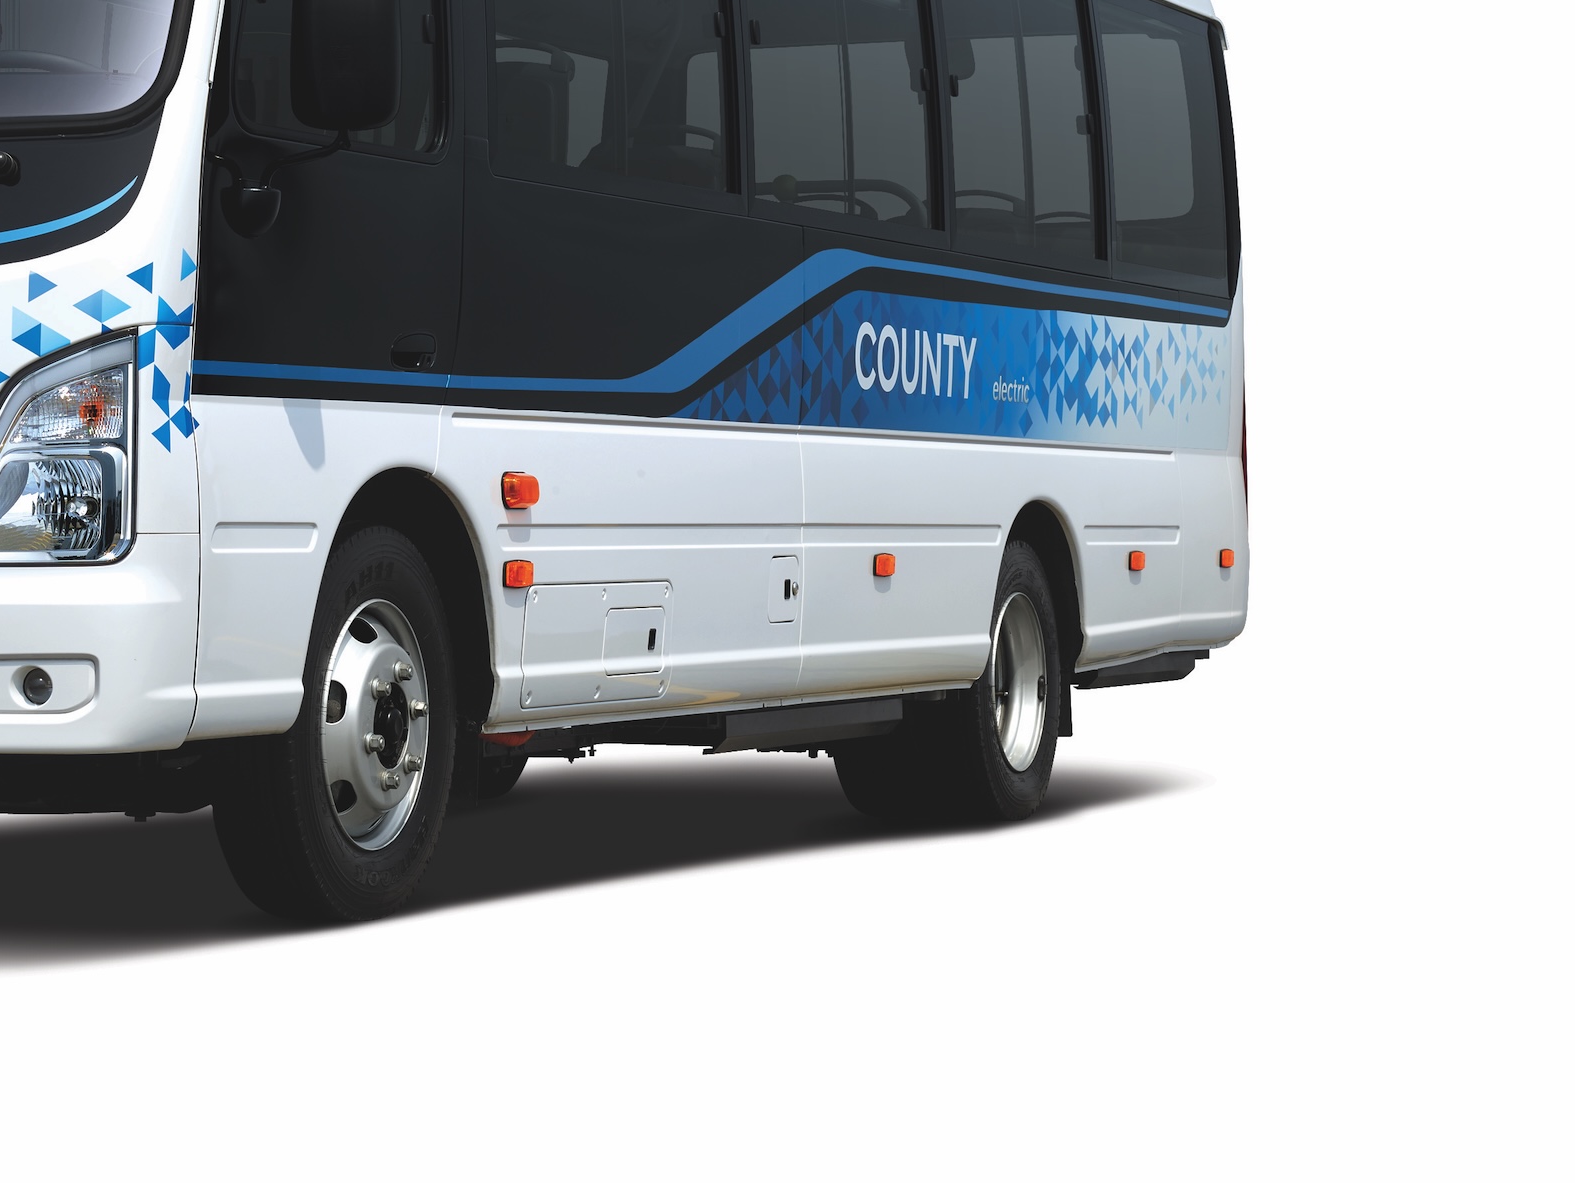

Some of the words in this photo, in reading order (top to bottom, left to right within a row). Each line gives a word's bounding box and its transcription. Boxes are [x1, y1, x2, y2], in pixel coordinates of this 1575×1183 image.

[855, 321, 977, 399] COUNTY
[992, 376, 1030, 403] electric
[344, 560, 395, 610] AH11
